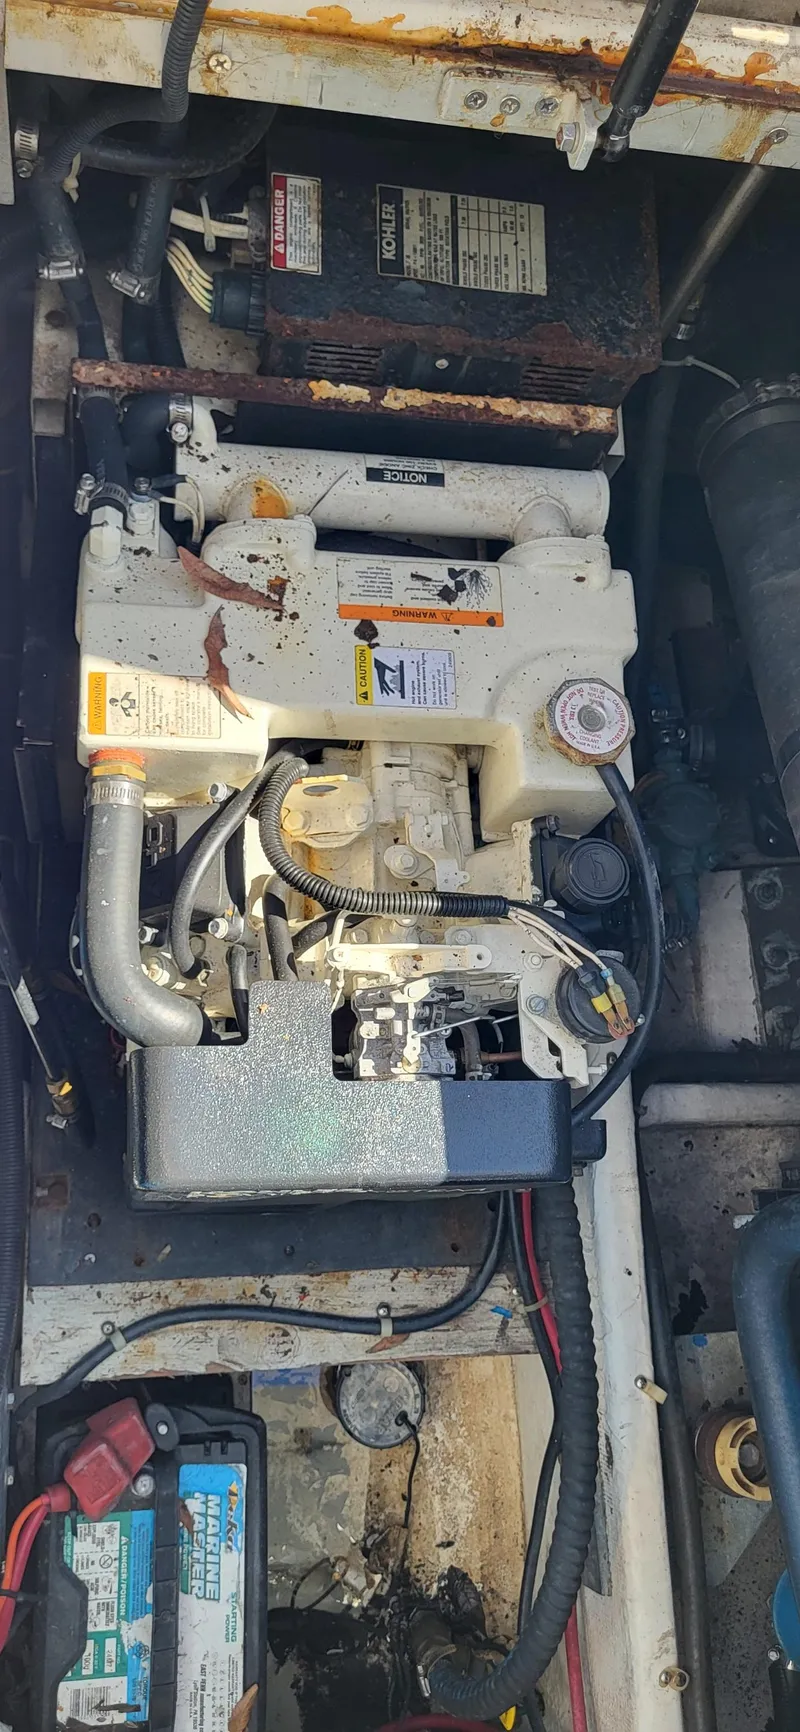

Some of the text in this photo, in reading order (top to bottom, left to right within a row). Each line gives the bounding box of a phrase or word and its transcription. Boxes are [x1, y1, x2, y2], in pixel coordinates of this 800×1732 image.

[274, 189, 284, 241] DANGER
[381, 203, 397, 260] KOHLER
[383, 471, 427, 483] NOTICE
[392, 610, 437, 619] WARNING
[359, 649, 367, 687] CAUTION
[93, 677, 102, 719] WARNING
[560, 700, 568, 713] OPEN
[568, 690, 577, 701] NOT
[577, 687, 584, 695] DO
[567, 731, 577, 741] HOT
[580, 736, 599, 744] COOLANT
[606, 699, 626, 746] CAUTION PRESSURE
[226, 1483, 238, 1553] Deka
[190, 1492, 206, 1598] MASTER
[205, 1494, 220, 1600] MARINE
[119, 1545, 127, 1615] DANGER/POISON
[230, 1592, 238, 1643] STARTING
